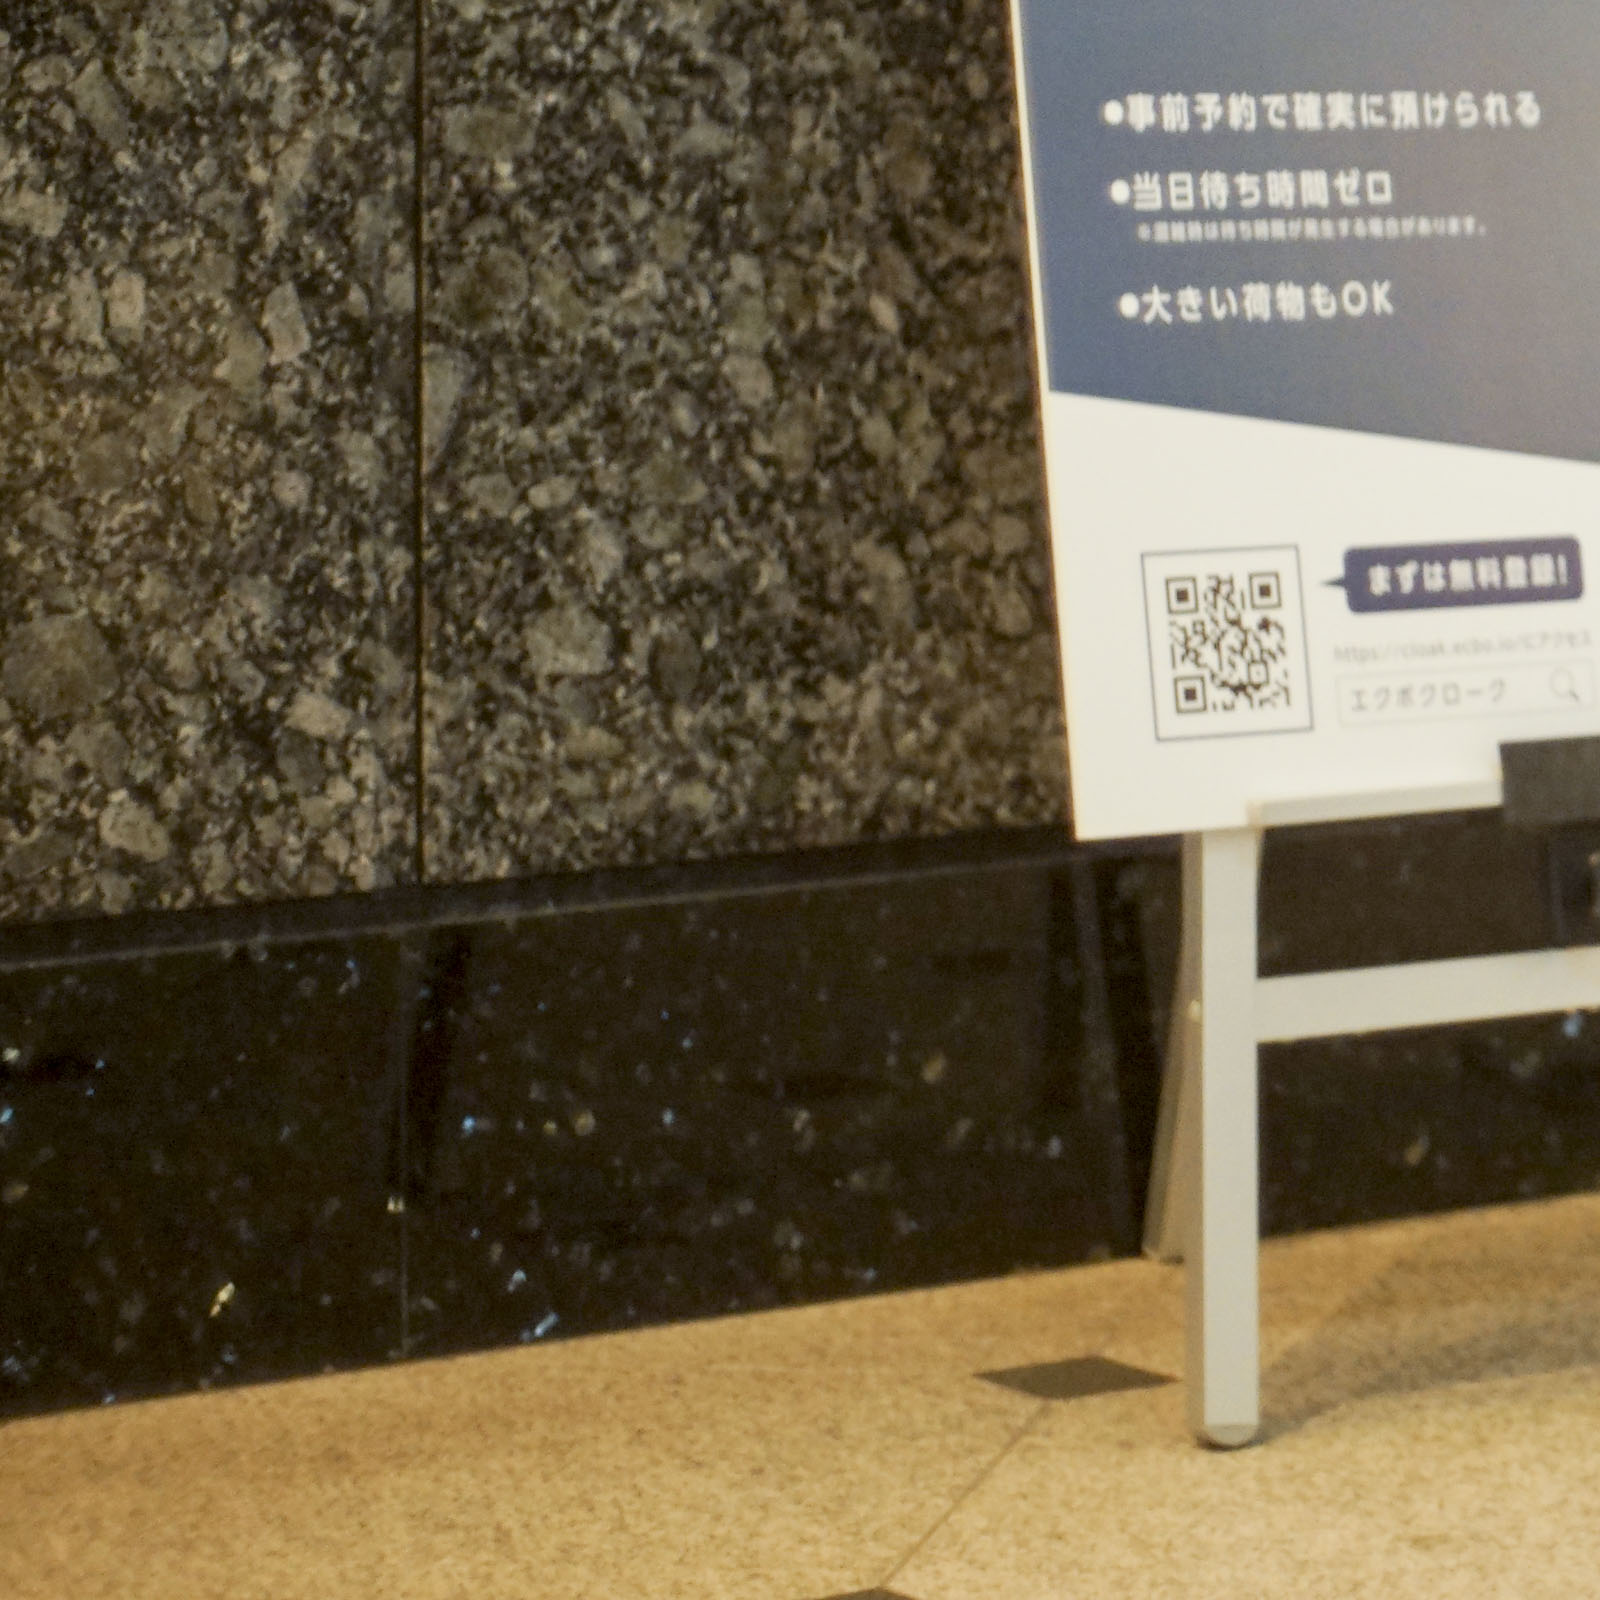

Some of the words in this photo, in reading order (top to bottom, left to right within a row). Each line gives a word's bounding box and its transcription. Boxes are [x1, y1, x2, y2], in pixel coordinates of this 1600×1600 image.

[1132, 168, 1394, 211] 当日待ち時間ゼロ
[1141, 280, 1395, 325] 大きい荷物もOK
[1351, 677, 1506, 712] エクボクローク
